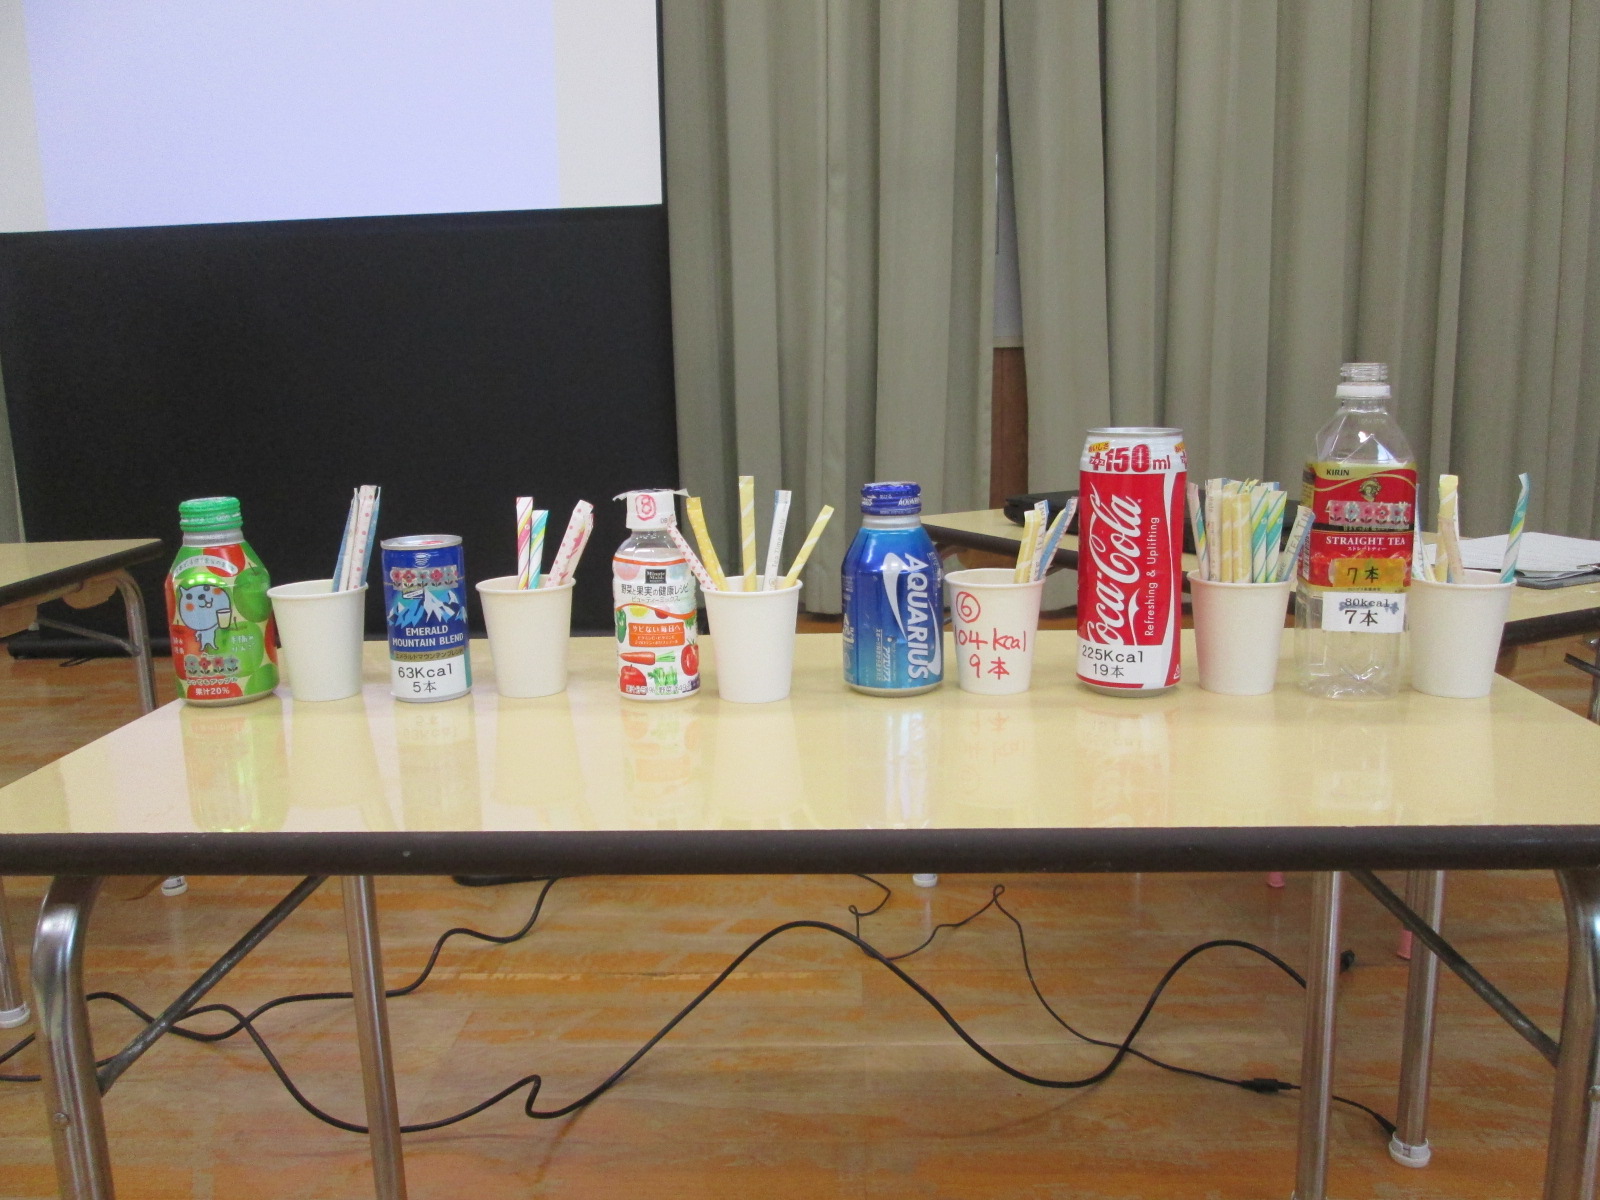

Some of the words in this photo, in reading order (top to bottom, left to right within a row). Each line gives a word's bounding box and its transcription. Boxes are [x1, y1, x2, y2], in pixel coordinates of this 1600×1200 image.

[1326, 468, 1350, 476] KIRIN
[1146, 517, 1160, 564] Uplifting
[1326, 536, 1385, 545] STRAIGHT
[1387, 537, 1406, 546] TEA
[1145, 569, 1156, 577] &
[621, 583, 689, 597] 野菜と果実の健康レシピ
[1144, 582, 1158, 636] Refreshing
[1345, 598, 1390, 608] 80kcal
[904, 552, 929, 680] AQUARIUS
[1344, 609, 1379, 627] 7本
[405, 625, 449, 637] EMERALD
[392, 637, 436, 648] MOUNTAIN
[439, 633, 464, 645] BLEND
[1082, 644, 1144, 663] 225Kcal
[398, 663, 453, 679] 63Kcal
[1093, 663, 1125, 678] 19本
[195, 687, 230, 696] 果汁20%
[412, 680, 437, 693] 5本
